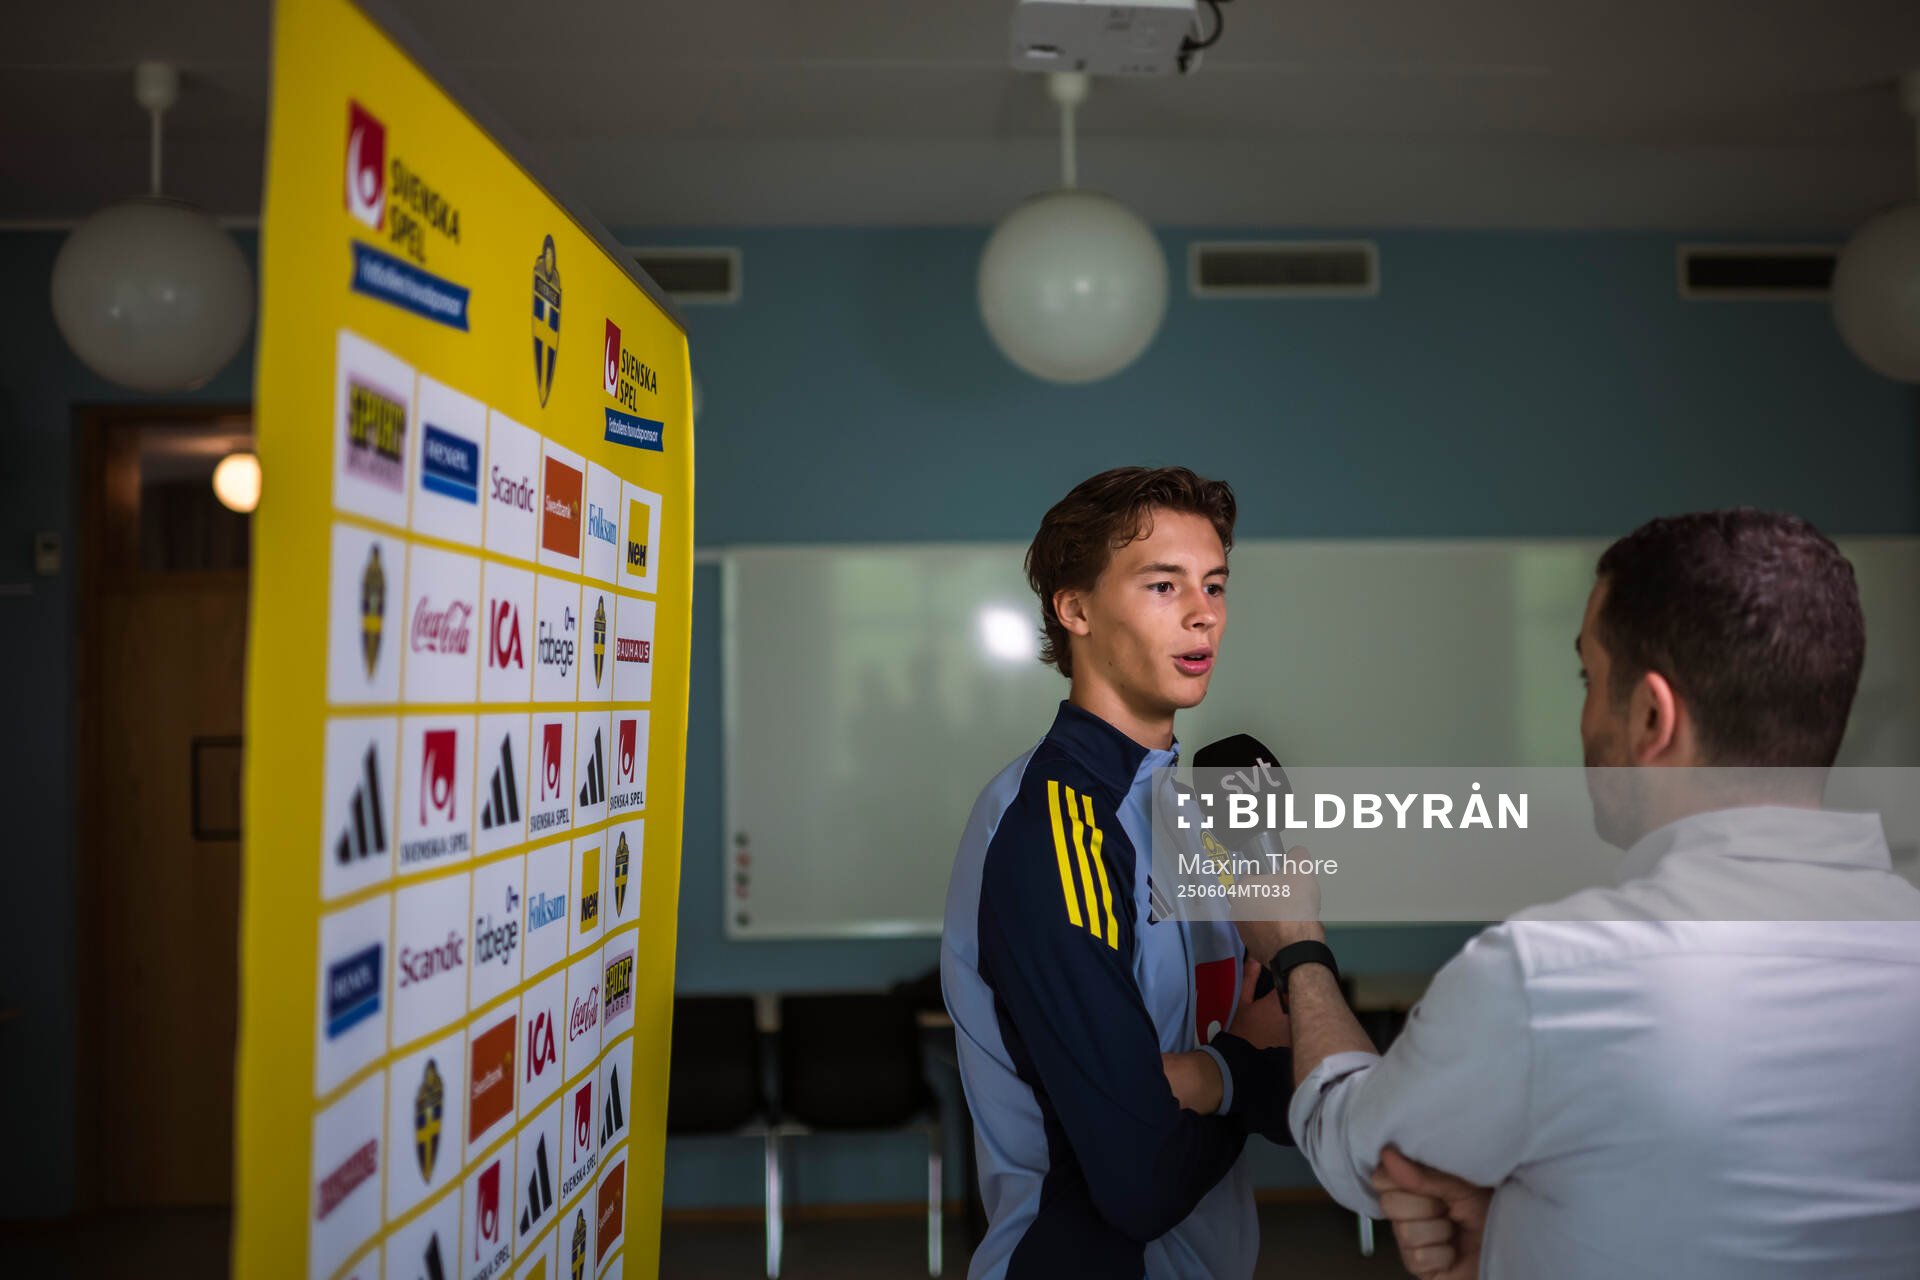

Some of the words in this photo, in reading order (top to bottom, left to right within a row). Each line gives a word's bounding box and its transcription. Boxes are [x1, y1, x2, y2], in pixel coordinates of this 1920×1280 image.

[392, 159, 460, 245] SVENSKA
[390, 204, 426, 264] SPEL
[622, 348, 657, 395] SVENSKA
[620, 379, 637, 412] SPEL
[491, 465, 534, 513] Scandic
[588, 503, 617, 545] Folksam
[489, 598, 524, 670] ICA
[538, 621, 574, 677] Fabege
[617, 640, 649, 660] BAUHAUS
[610, 795, 629, 811] SVENSKA
[630, 791, 644, 806] SPEL
[1221, 757, 1281, 802] svt
[530, 811, 555, 832] SVENSKA
[556, 808, 570, 826] SPEL
[400, 930, 464, 988] Scandic
[605, 957, 632, 1004] SPORT
[527, 1008, 556, 1084] ICA
